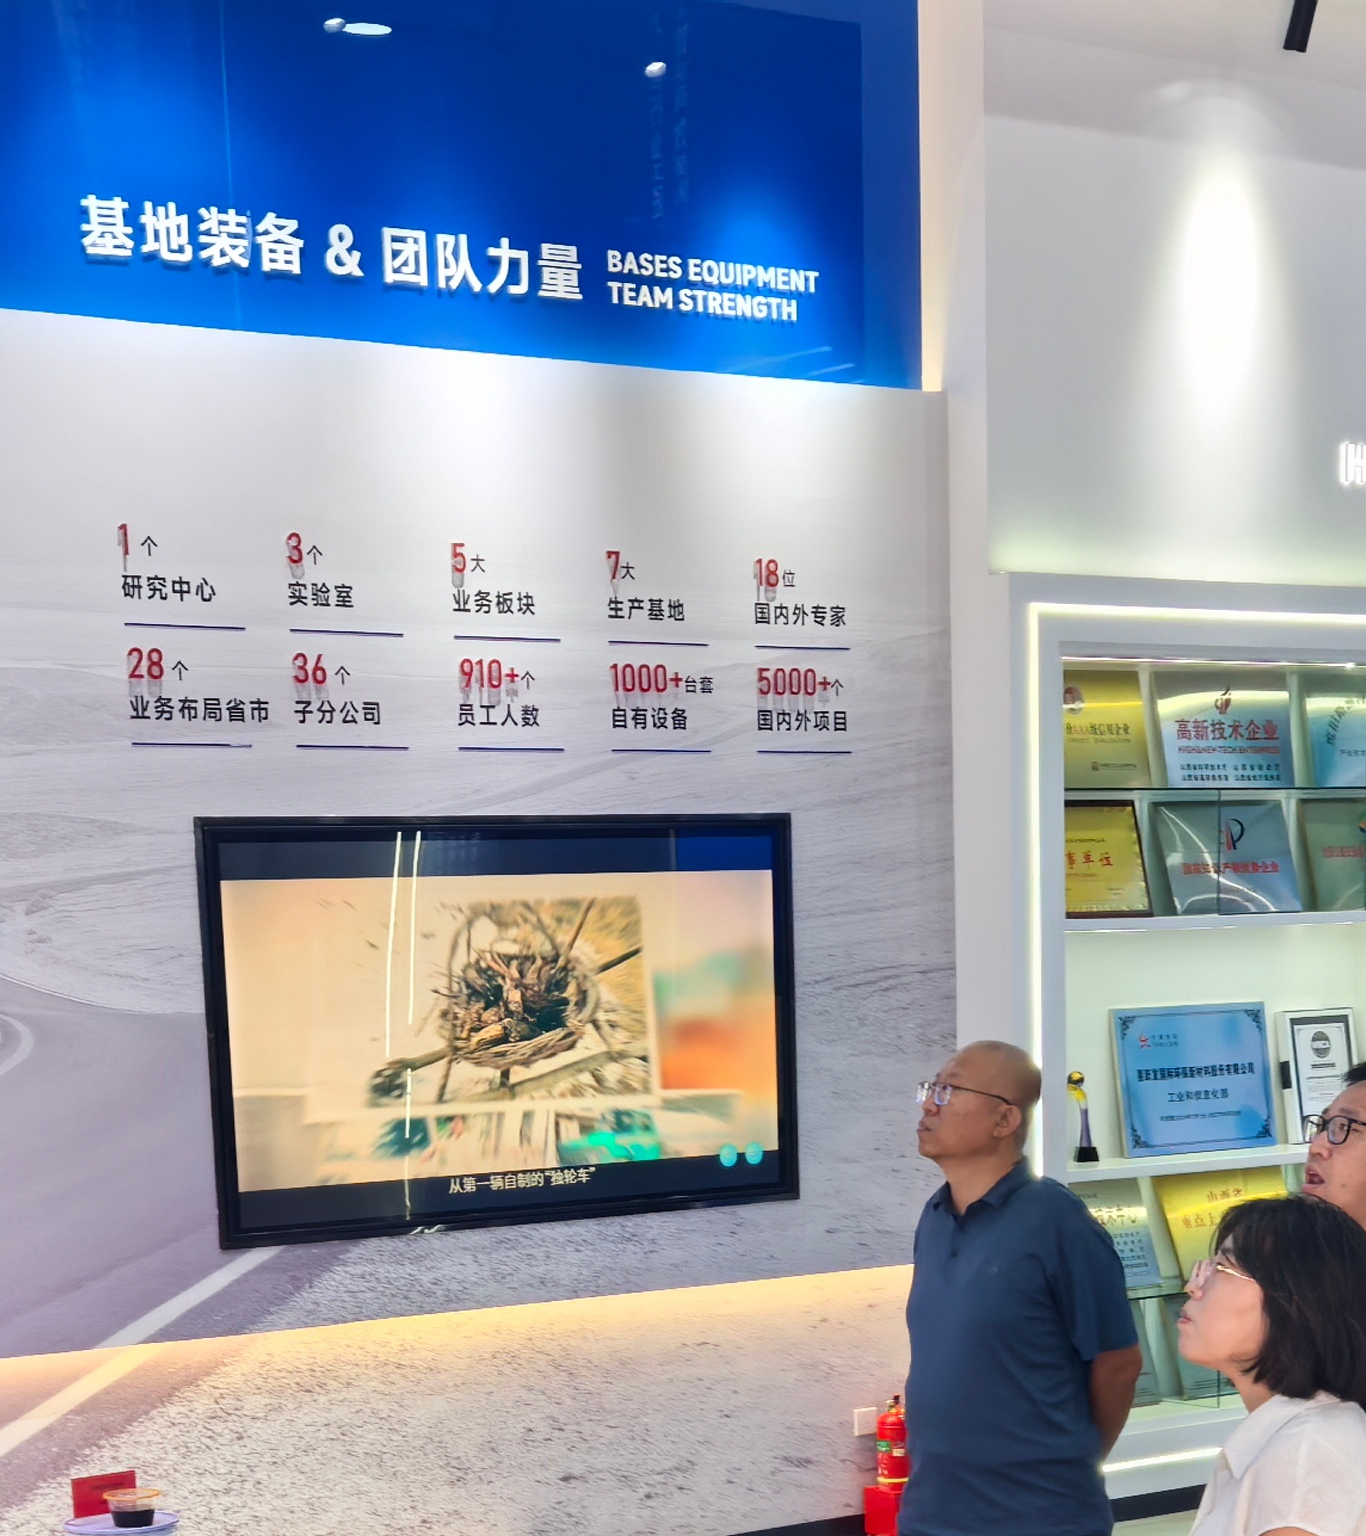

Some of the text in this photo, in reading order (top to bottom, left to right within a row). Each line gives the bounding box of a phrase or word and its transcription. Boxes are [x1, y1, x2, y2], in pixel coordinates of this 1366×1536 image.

[79, 193, 584, 303] 基地装备 & 团队力量
[606, 249, 820, 296] BASES EQUIPMENT
[607, 281, 798, 322] TEAM STRENGTH
[121, 574, 217, 603] 研究中心
[287, 581, 355, 609] 实验室
[452, 588, 536, 616] 业务板块
[607, 597, 685, 622] 生产基地
[754, 602, 847, 628] 国内外专家
[129, 695, 270, 723] 业务布局省市
[294, 700, 382, 726] 子分公司
[457, 703, 541, 728] 员工人数
[611, 706, 689, 731] 自有设备
[756, 709, 849, 733] 国内外项目
[1174, 717, 1280, 741] 高新技术企业
